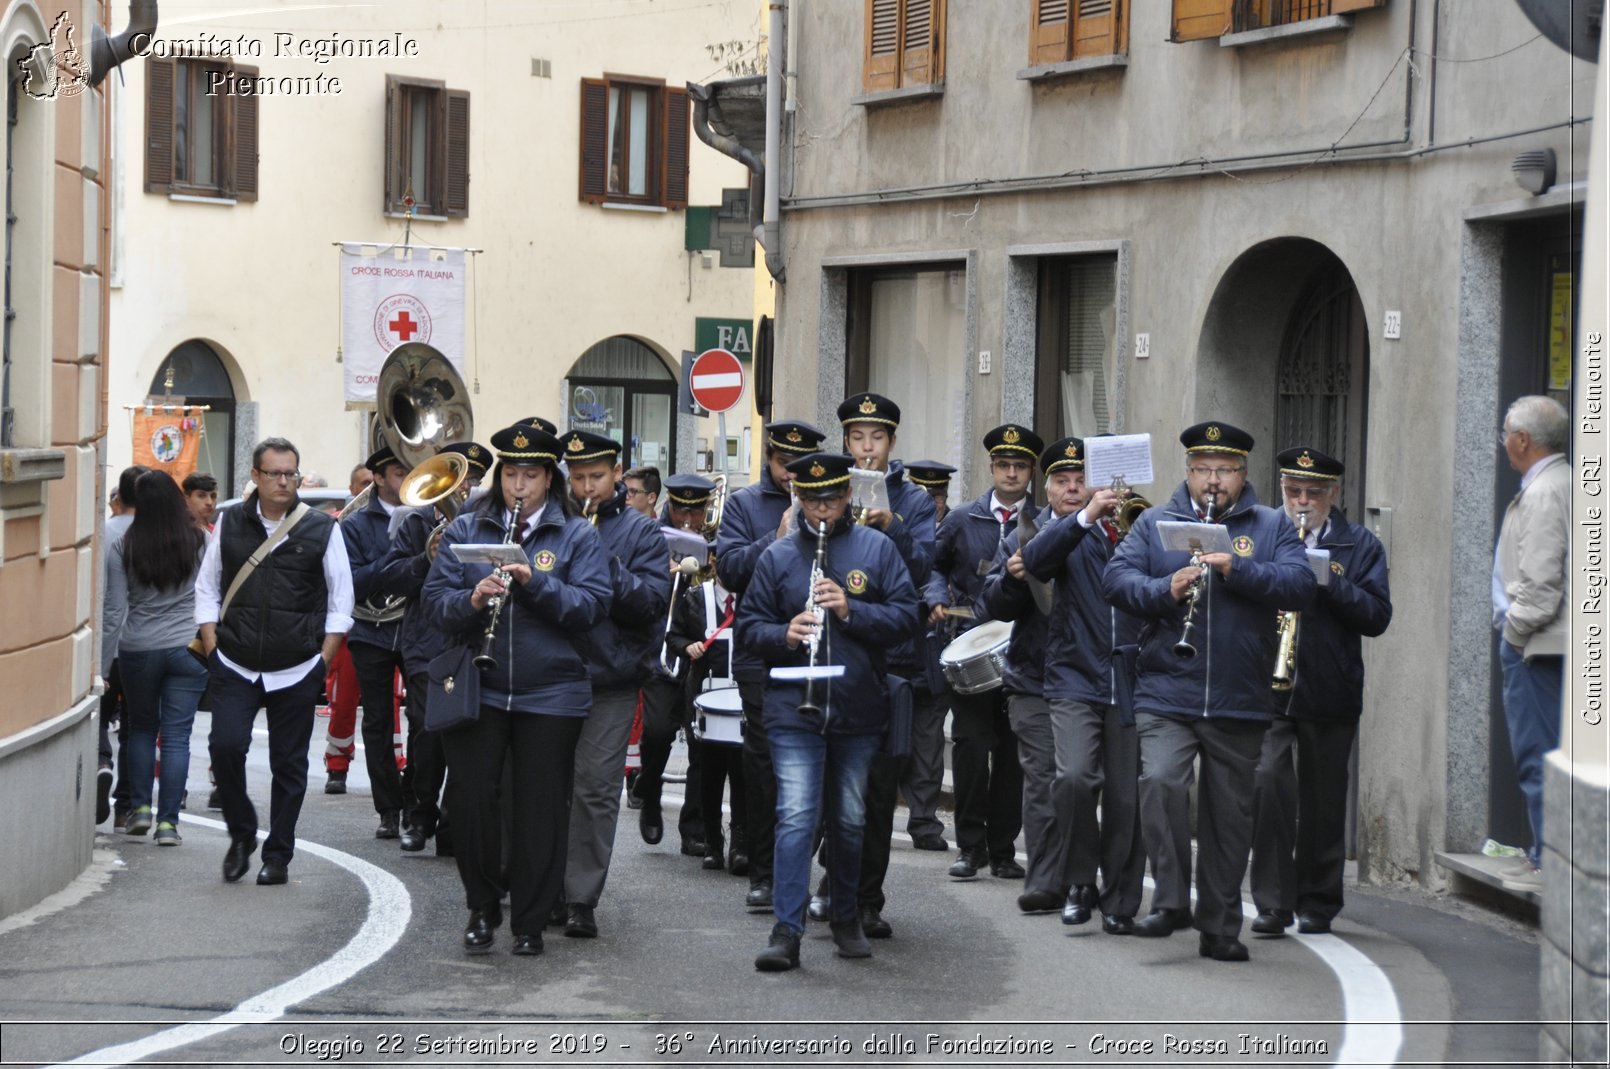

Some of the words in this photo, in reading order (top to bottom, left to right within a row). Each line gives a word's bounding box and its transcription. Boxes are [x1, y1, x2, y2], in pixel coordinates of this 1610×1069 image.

[352, 267, 382, 276] CROCE
[384, 268, 415, 278] ROSSA
[417, 270, 454, 280] ITALIANA
[1387, 315, 1396, 334] 22
[1138, 336, 1146, 354] 24
[981, 354, 988, 370] 26
